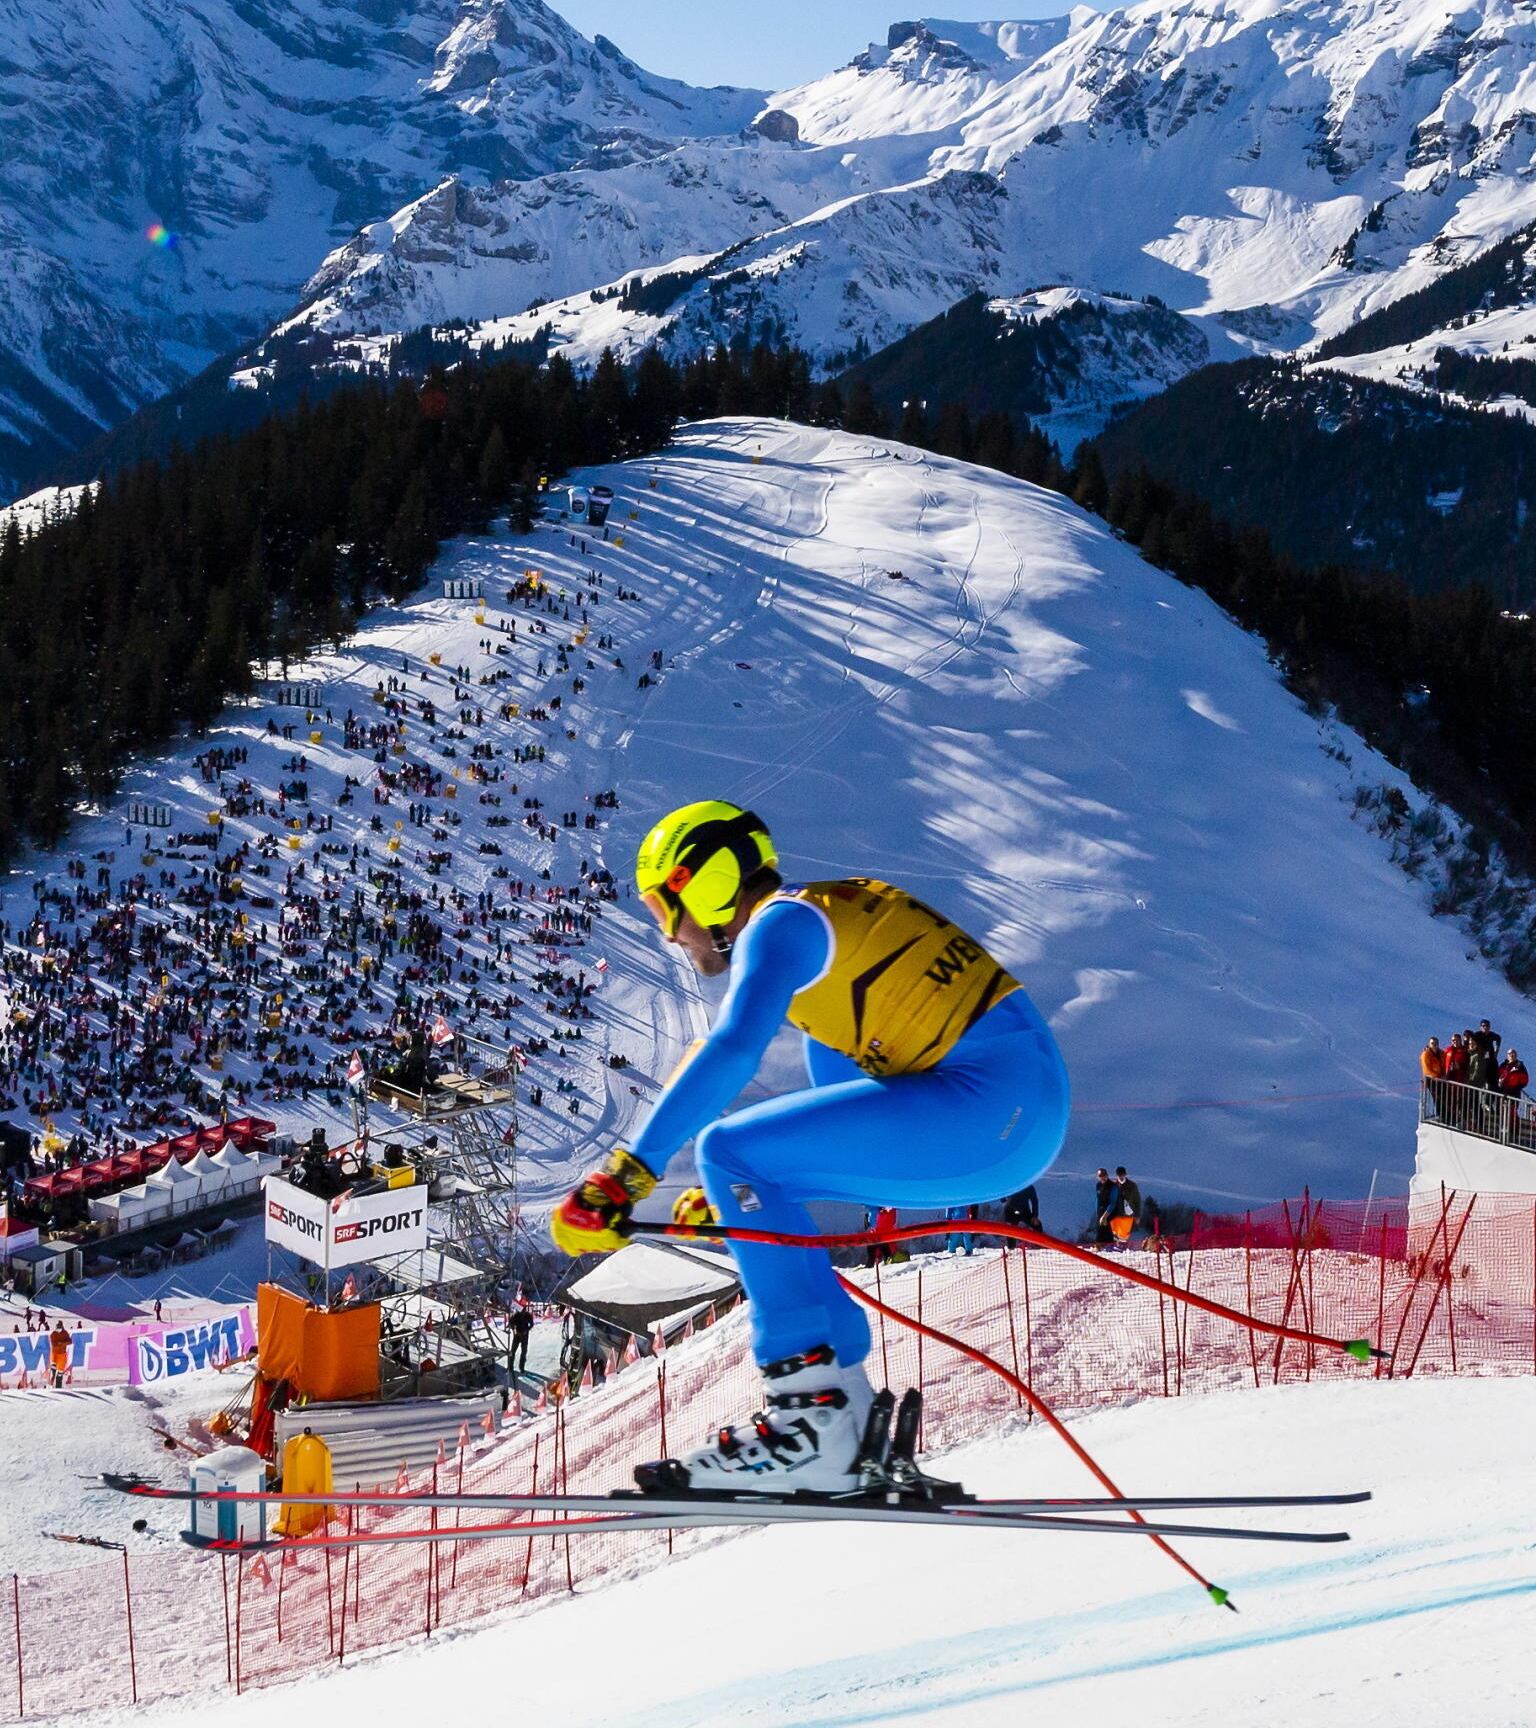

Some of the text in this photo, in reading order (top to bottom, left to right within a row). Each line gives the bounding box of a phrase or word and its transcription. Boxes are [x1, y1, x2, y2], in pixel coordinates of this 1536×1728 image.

[281, 1208, 323, 1242] SPORT
[336, 1209, 423, 1240] SRF SPORT
[165, 1316, 239, 1377] BWT
